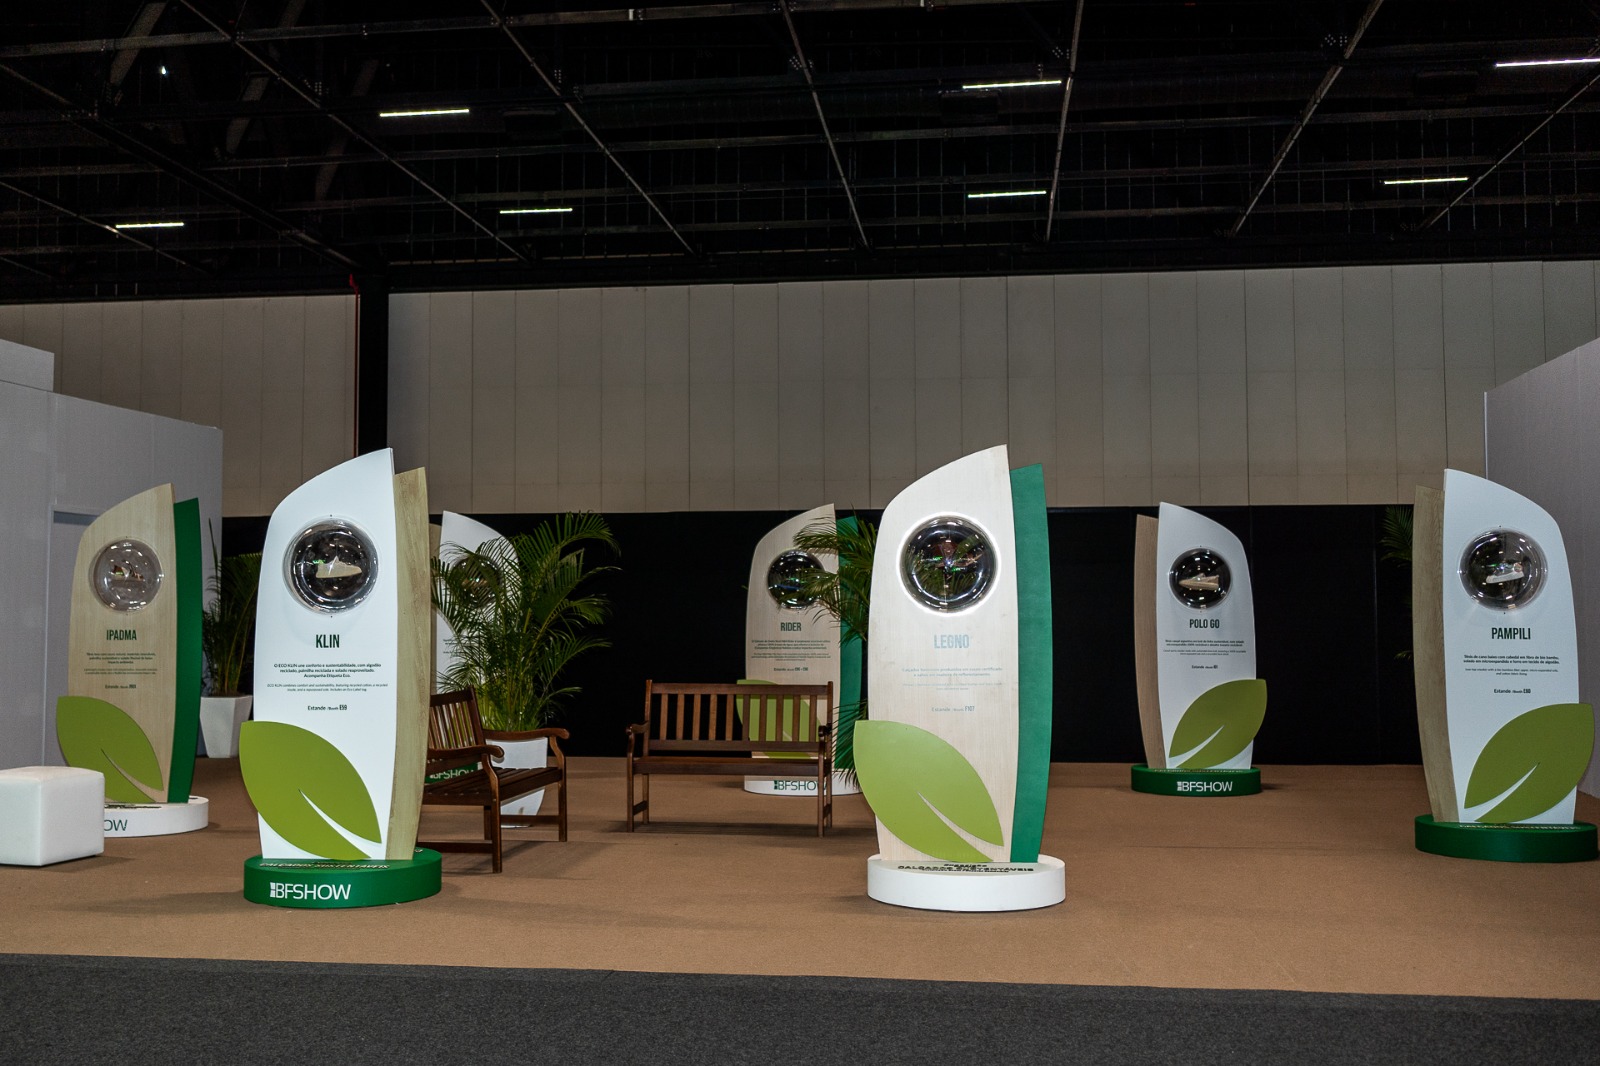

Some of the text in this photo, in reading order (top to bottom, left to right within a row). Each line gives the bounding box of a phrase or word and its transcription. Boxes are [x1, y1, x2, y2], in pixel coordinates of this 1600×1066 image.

[780, 622, 802, 632] RIDER
[1189, 618, 1220, 629] POLO GO
[106, 629, 138, 641] IPADMA
[1491, 627, 1531, 640] PAMPILI
[315, 634, 340, 649] KLIN
[933, 634, 970, 649] LEGNO
[1182, 781, 1233, 792] BFSHOW
[275, 882, 352, 900] BFSHOW
